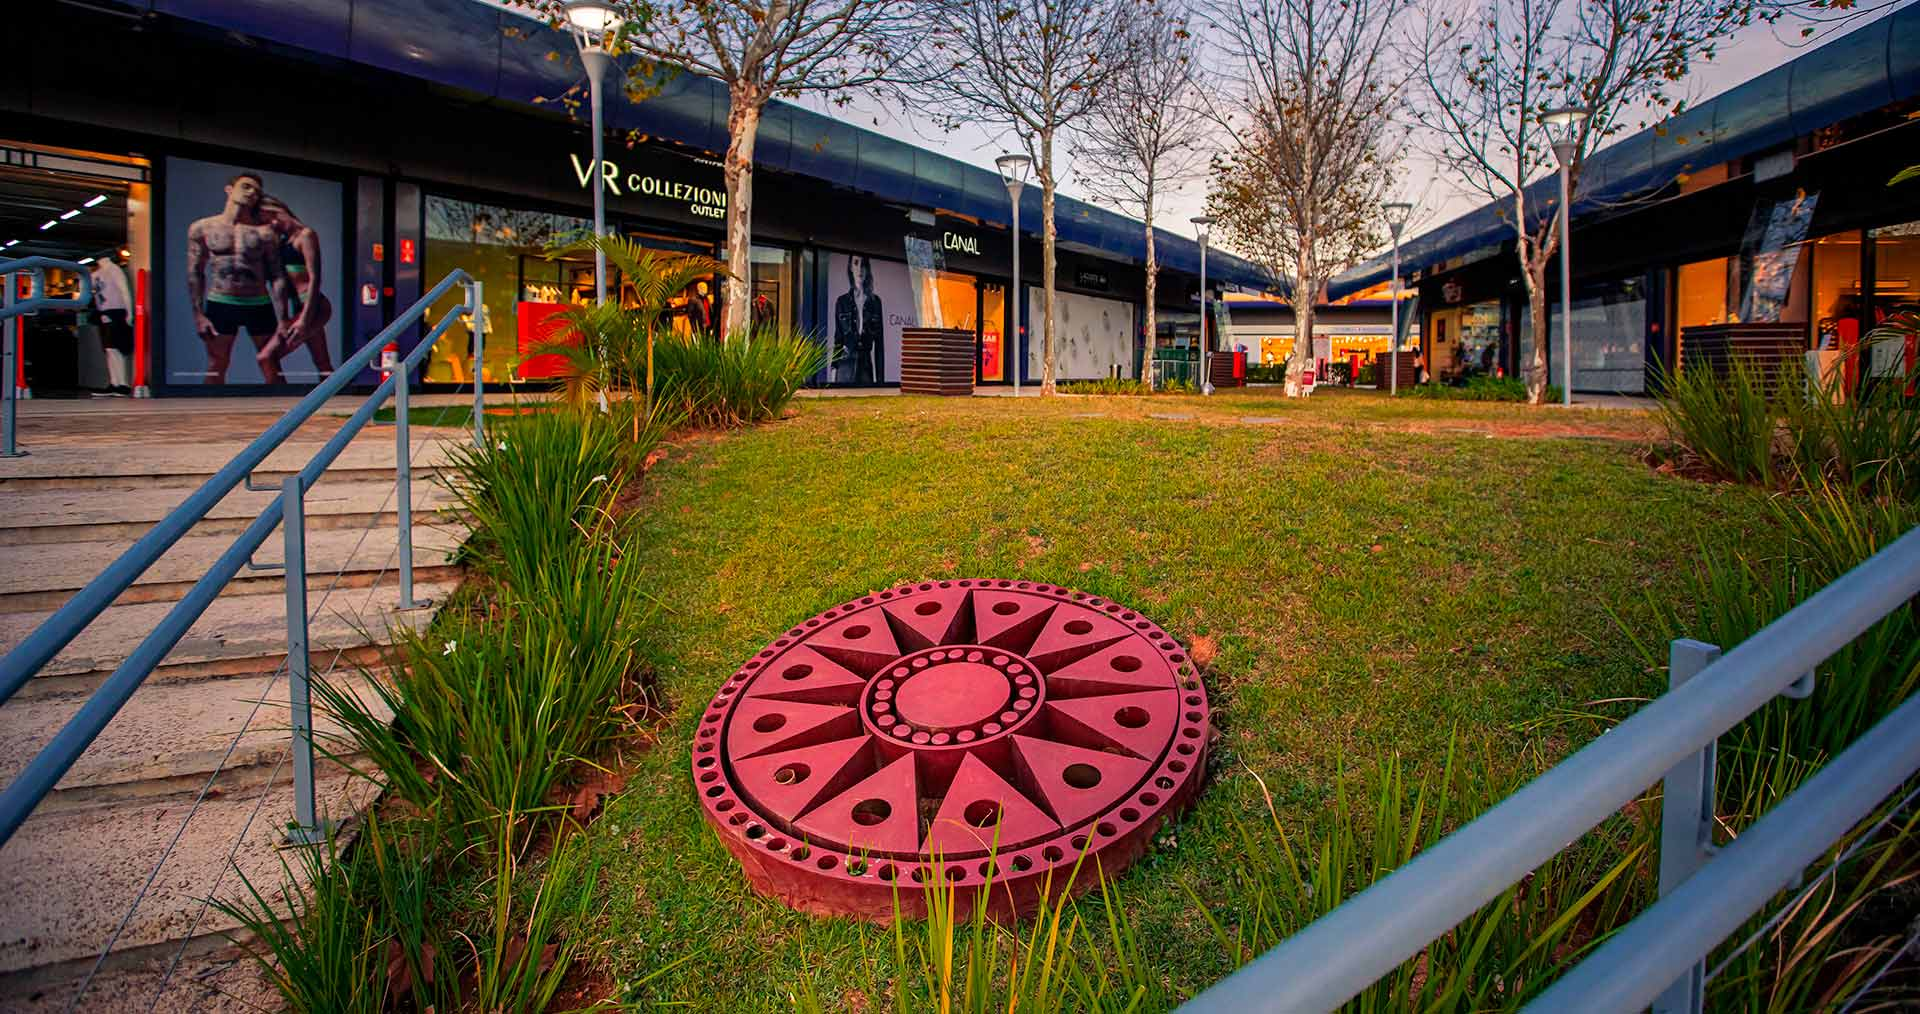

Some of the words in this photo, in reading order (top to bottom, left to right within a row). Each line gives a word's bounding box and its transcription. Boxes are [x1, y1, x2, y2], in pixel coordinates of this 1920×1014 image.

[570, 153, 622, 195] VR
[627, 173, 727, 208] COLLEZIONI
[690, 203, 726, 220] OUTLET
[943, 231, 981, 255] CANAL
